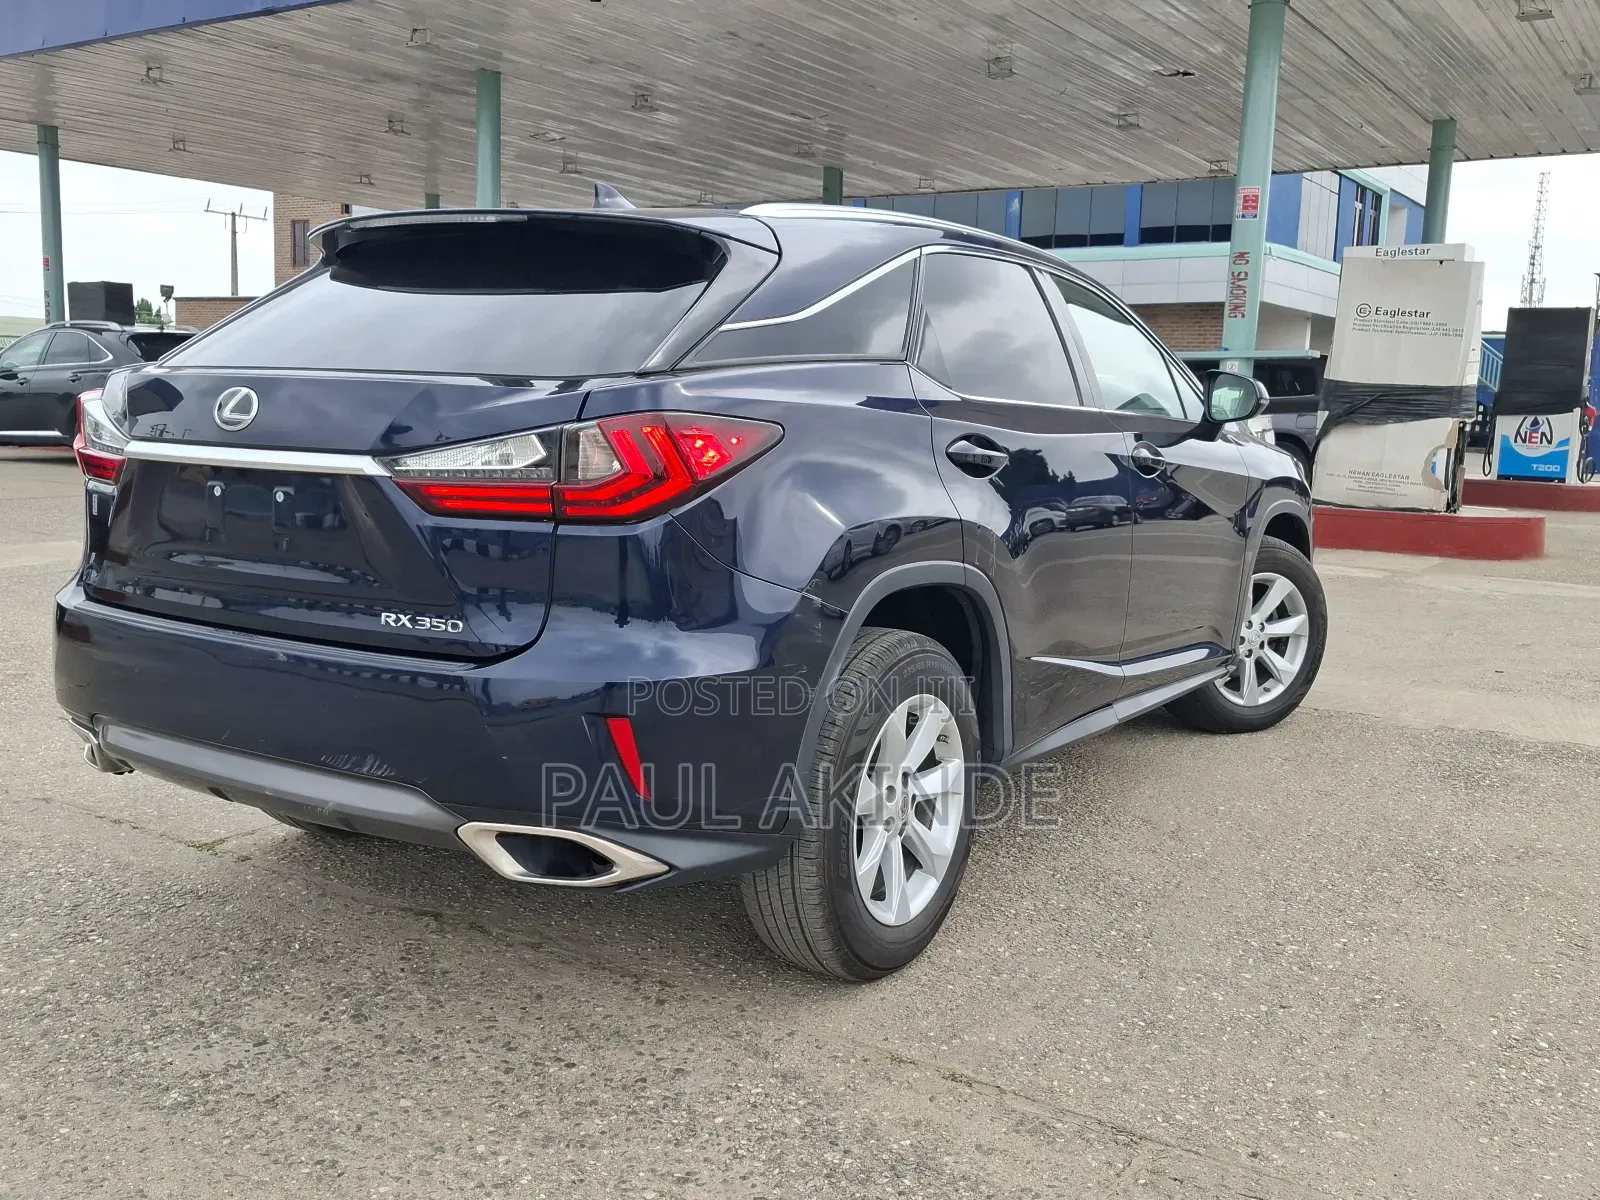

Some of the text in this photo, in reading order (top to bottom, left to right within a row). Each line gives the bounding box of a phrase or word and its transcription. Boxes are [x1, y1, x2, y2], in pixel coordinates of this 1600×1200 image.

[1376, 247, 1431, 258] Eaglestar
[1228, 251, 1251, 319] NO SMOKING
[1374, 306, 1431, 318] Eaglestar
[1514, 416, 1553, 445] NEN
[1531, 464, 1560, 472] T200
[1348, 469, 1371, 477] HENAN
[1371, 472, 1410, 481] EAGLESTAR
